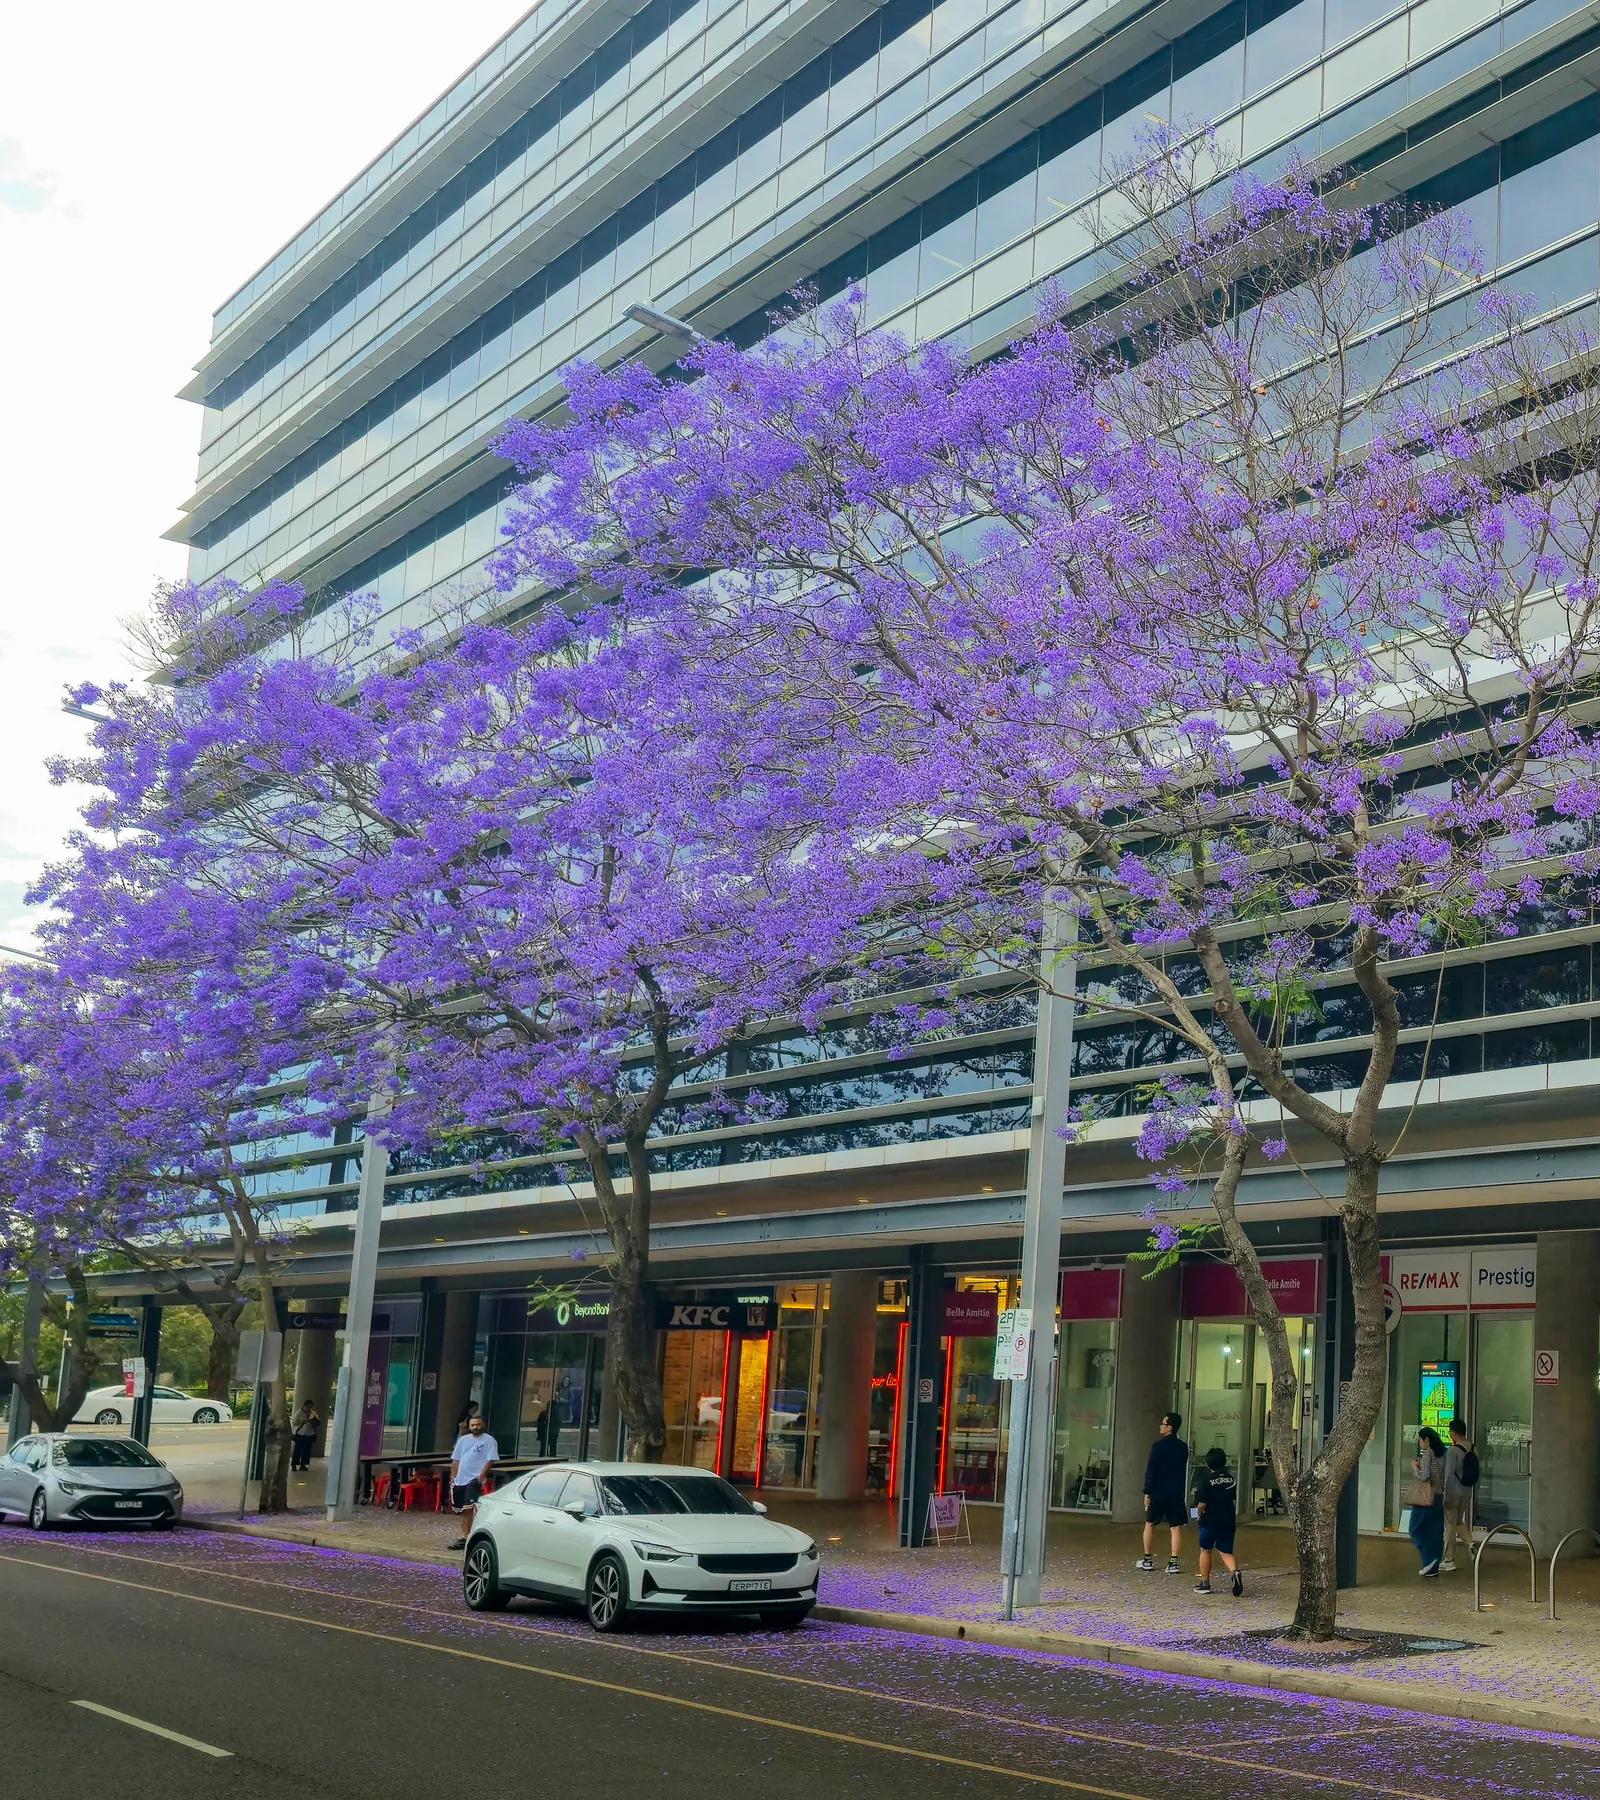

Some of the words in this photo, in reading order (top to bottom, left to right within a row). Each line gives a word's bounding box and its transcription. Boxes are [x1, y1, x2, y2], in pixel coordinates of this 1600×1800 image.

[1280, 1279, 1301, 1289] Amitie
[1400, 1271, 1460, 1290] RE/MAX
[574, 1304, 597, 1318] Beyond
[669, 1305, 731, 1326] KFC
[946, 1307, 964, 1317] Belle
[965, 1307, 990, 1318] Amitie
[999, 1312, 1014, 1324] 2P
